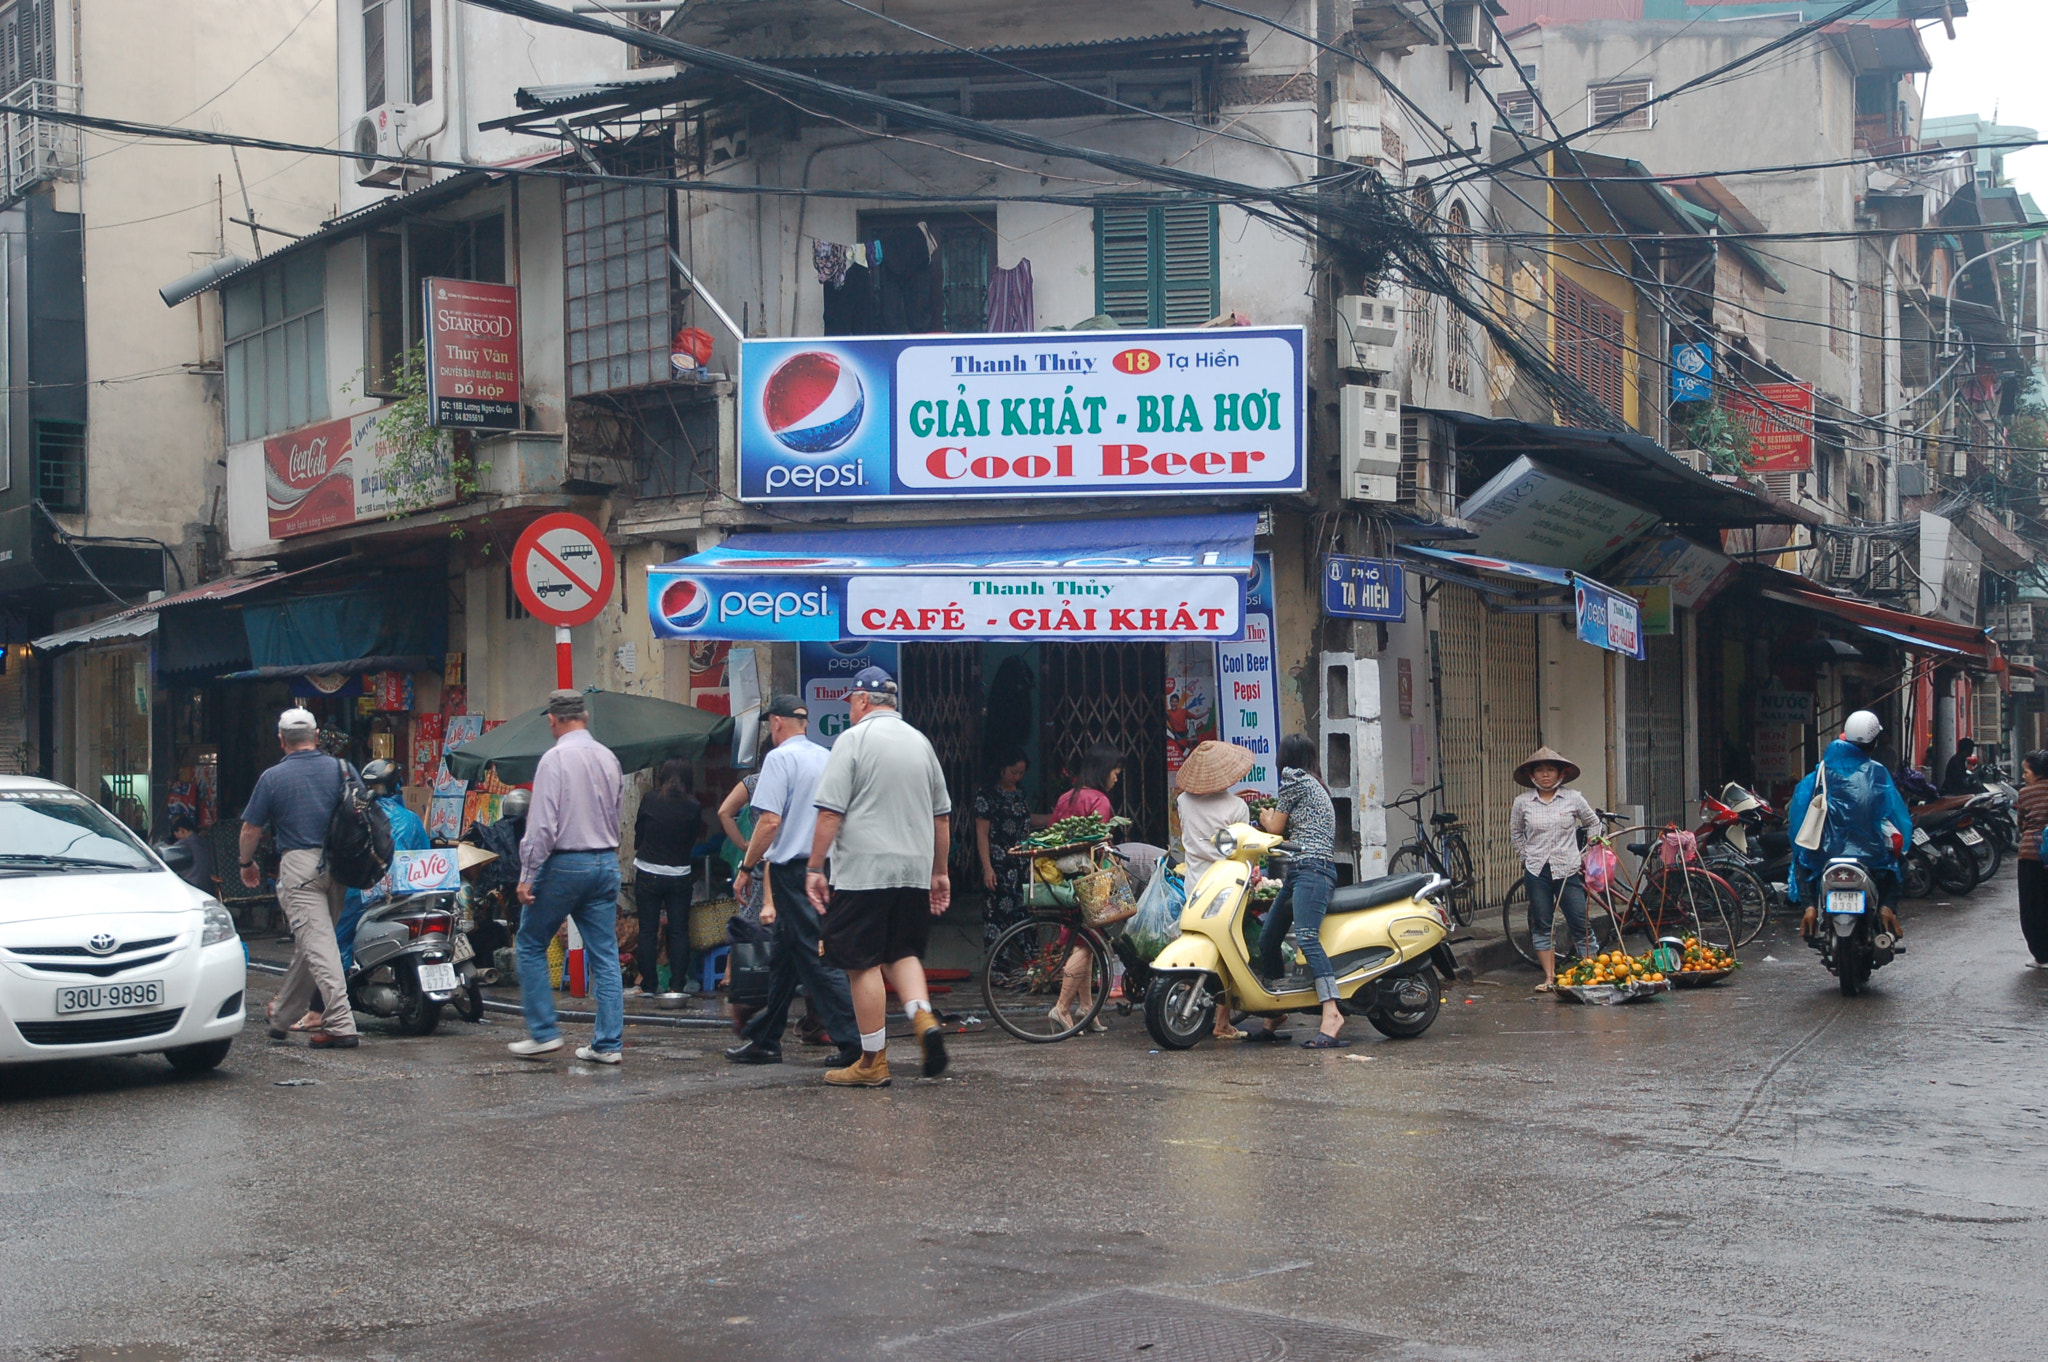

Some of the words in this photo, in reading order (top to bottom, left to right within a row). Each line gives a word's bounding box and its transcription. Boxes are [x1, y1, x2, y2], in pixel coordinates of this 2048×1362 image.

[438, 309, 512, 338] STARFOOD
[482, 348, 509, 364] Vân
[951, 355, 1027, 374] Thanh
[1035, 351, 1097, 374] Thủy
[1125, 352, 1150, 371] 18
[1167, 353, 1189, 372] Tạ
[1196, 349, 1239, 368] Hiền
[478, 383, 504, 400] HỘP
[909, 383, 991, 438] GIẢI
[1000, 385, 1107, 436] KHÁT
[1137, 394, 1203, 433] BIA
[1213, 388, 1281, 432] HƠI
[926, 445, 1077, 480] Cool
[1098, 444, 1266, 476] Beer
[765, 458, 863, 494] pepsi
[969, 581, 1044, 596] Thanh
[1053, 579, 1115, 598] Thủy
[1341, 581, 1356, 608] TẠ
[1362, 582, 1390, 611] HIỆN
[719, 585, 828, 623] pepsi
[861, 602, 965, 631] CAFÉ
[1009, 600, 1097, 631] GIẢI
[1109, 602, 1225, 631] KHÁT
[1586, 602, 1607, 628] pepsi
[828, 656, 871, 671] pepsi
[1223, 654, 1245, 674] Cool
[1247, 653, 1269, 672] Beer
[1234, 681, 1261, 702] Pepsi
[1240, 709, 1258, 729] 7up
[1232, 735, 1270, 756] Mirinda
[1240, 767, 1266, 783] ater
[64, 984, 157, 1009] 30U-9896
